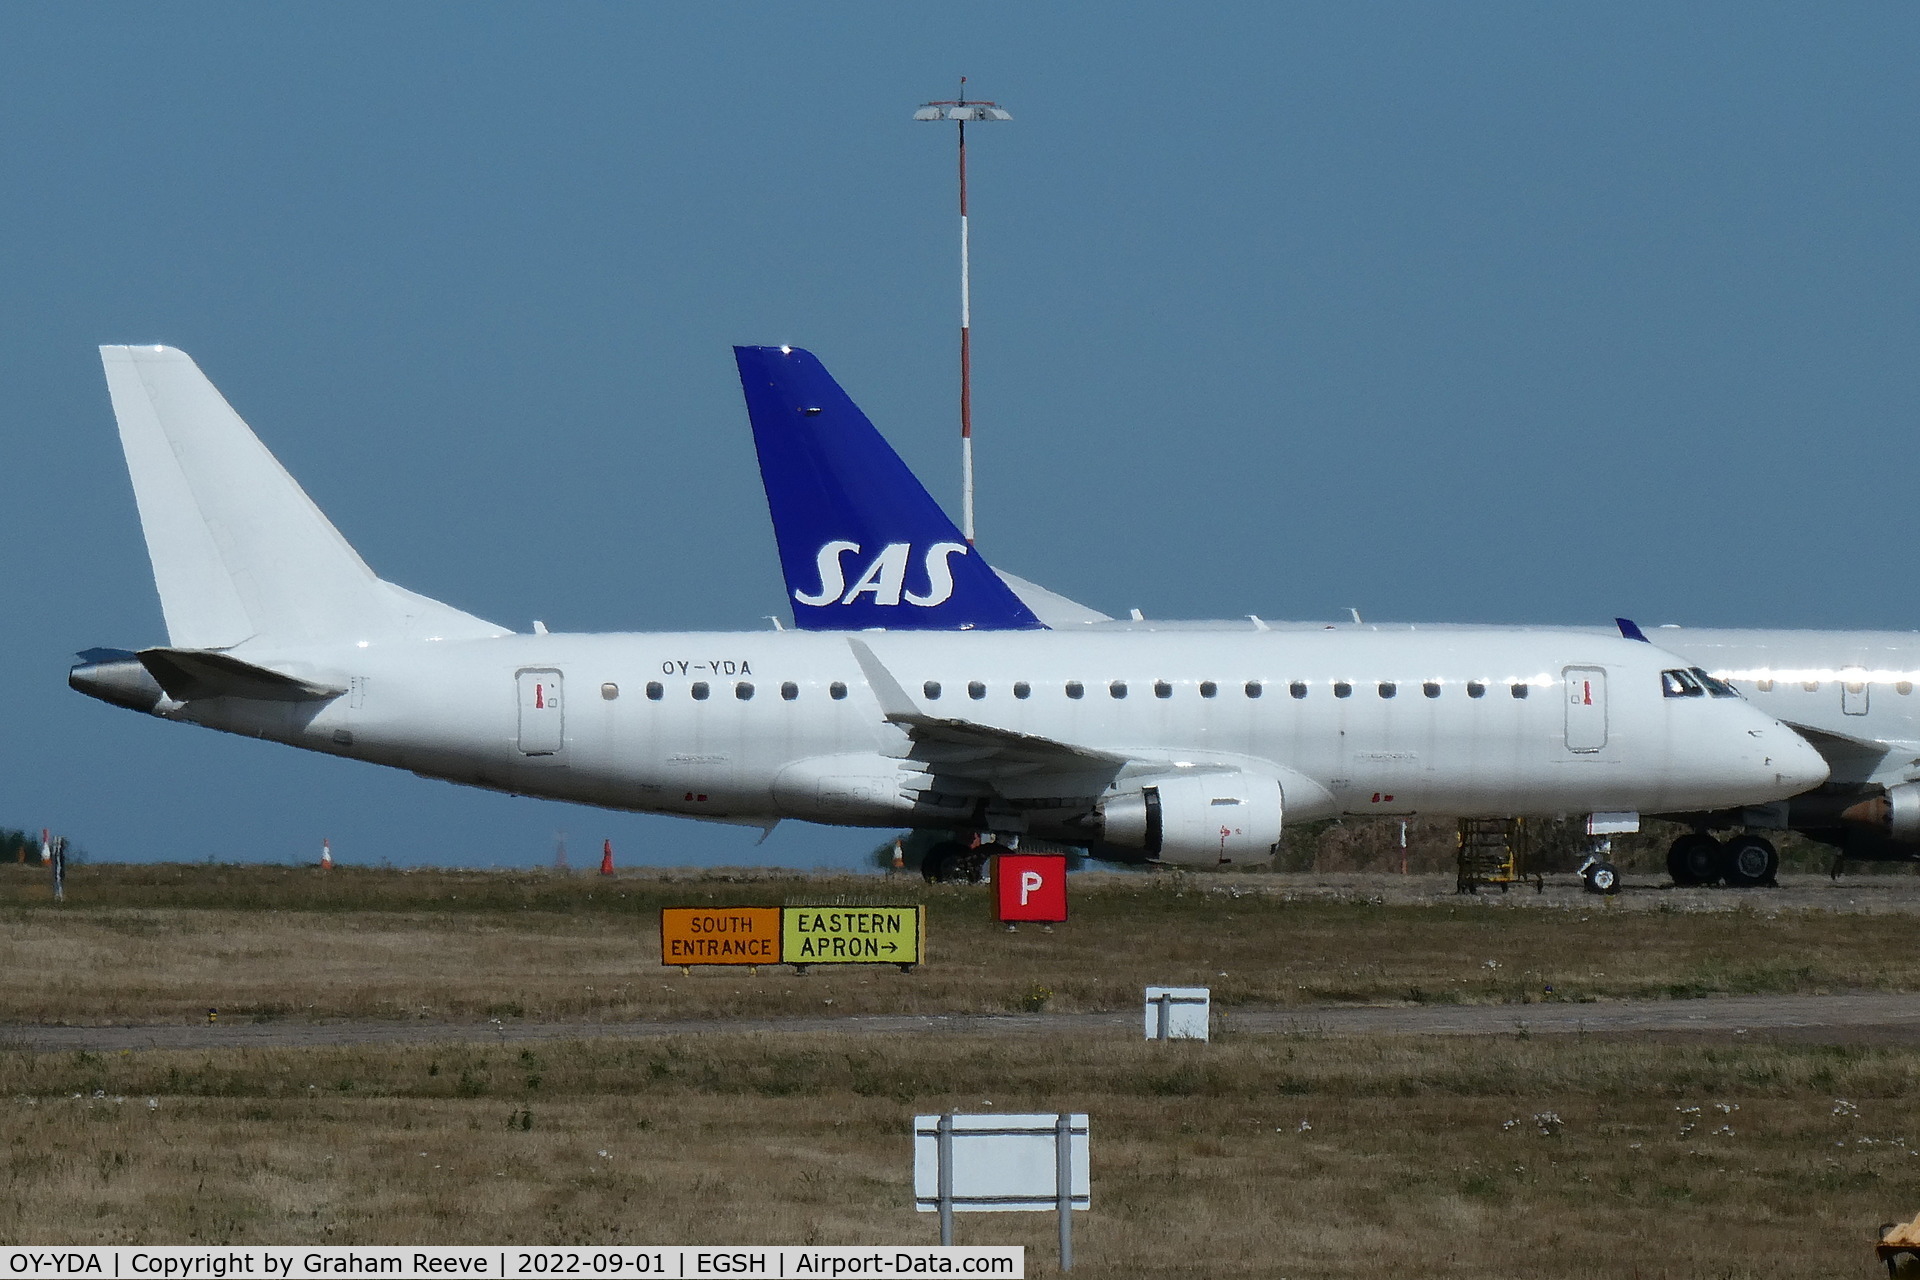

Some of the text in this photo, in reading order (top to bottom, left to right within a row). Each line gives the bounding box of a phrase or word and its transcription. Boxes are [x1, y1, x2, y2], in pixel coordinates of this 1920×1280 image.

[794, 541, 968, 607] SAS
[662, 660, 752, 676] OY-YDA
[1021, 871, 1043, 906] P
[690, 917, 753, 934] SOUTH
[798, 914, 901, 934] EASTERN
[671, 940, 772, 957] ENTRANCE
[800, 938, 879, 957] APRON
